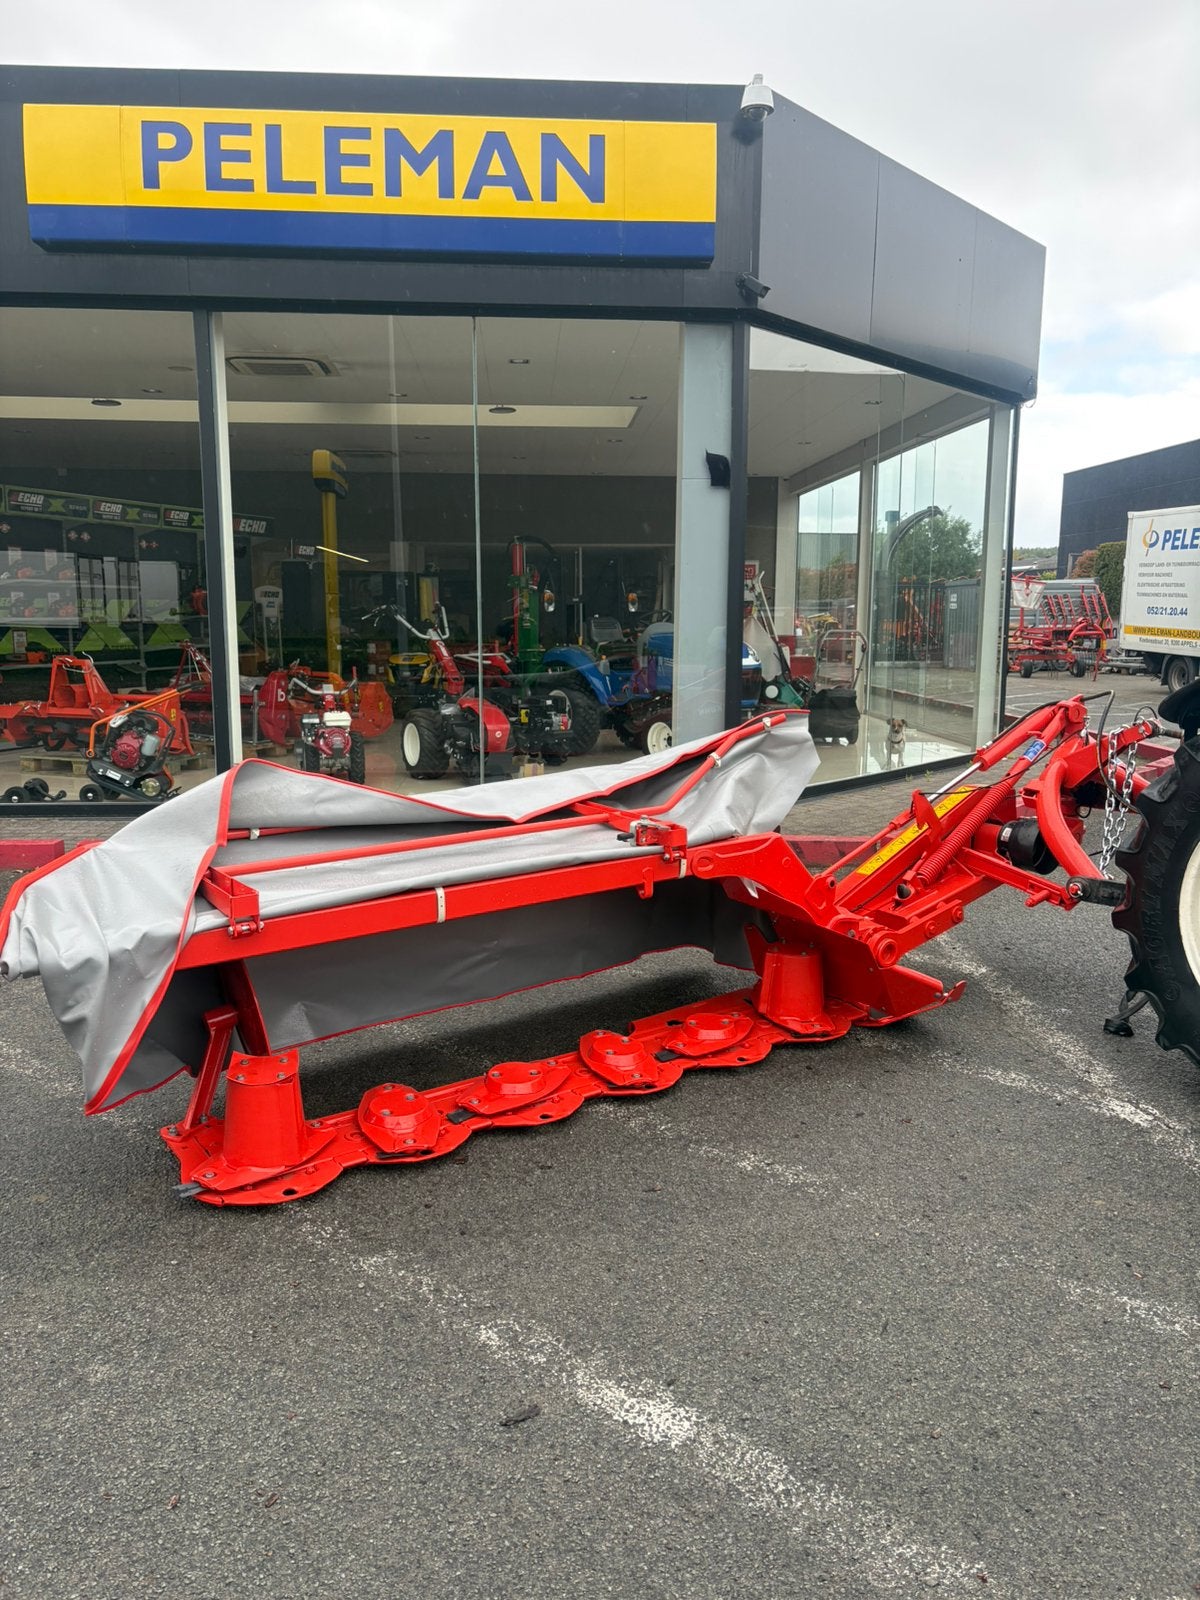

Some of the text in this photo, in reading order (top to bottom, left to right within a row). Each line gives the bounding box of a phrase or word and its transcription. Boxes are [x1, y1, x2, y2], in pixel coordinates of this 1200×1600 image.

[140, 120, 605, 203] PELEMAN
[17, 492, 44, 505] ECHO
[100, 502, 123, 513] ECHO
[170, 509, 190, 520] ECHO
[239, 518, 267, 533] ECHO
[1161, 527, 1200, 551] PELE
[298, 545, 316, 555] ECHO
[264, 590, 280, 598] ECHO
[1181, 640, 1198, 648] APPELS
